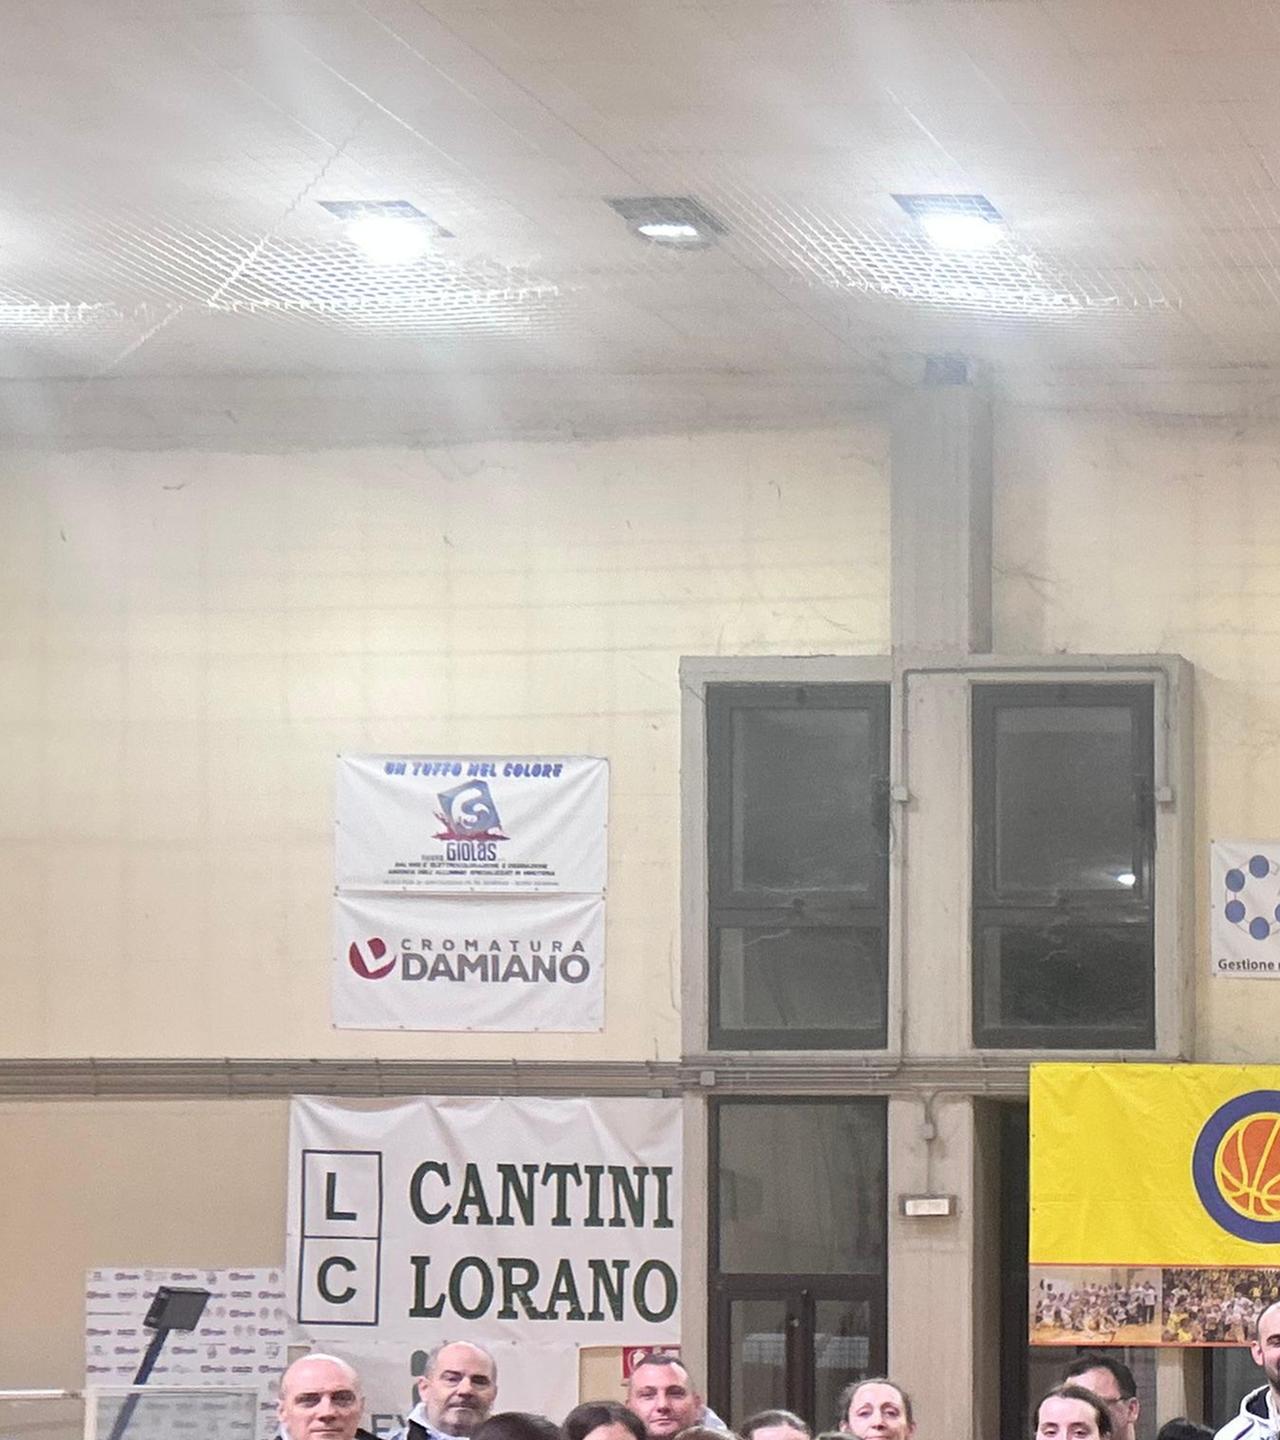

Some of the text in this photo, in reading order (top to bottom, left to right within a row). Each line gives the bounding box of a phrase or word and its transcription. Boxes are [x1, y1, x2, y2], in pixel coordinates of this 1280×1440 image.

[502, 763, 564, 778] COLORE
[401, 938, 585, 953] CROMATURA
[1218, 958, 1275, 972] Gestione
[401, 953, 591, 984] DAMIANO
[324, 1171, 358, 1221] L
[409, 1160, 676, 1229] CANTINI
[316, 1255, 358, 1304] C
[408, 1254, 680, 1324] LORANO
